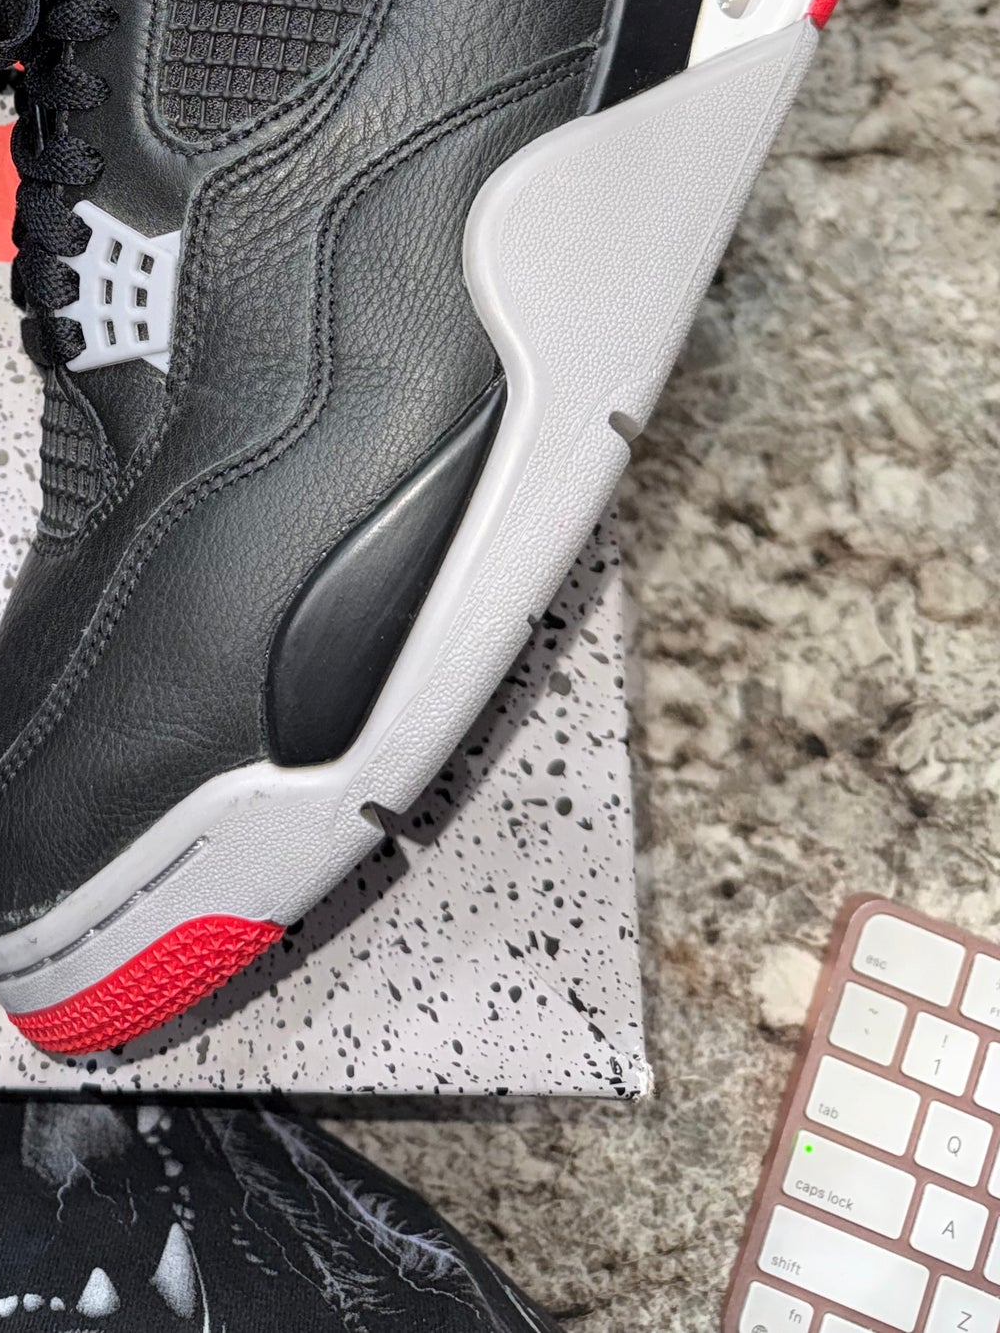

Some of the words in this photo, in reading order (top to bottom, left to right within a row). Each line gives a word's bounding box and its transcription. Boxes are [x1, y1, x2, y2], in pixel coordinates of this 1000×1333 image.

[865, 954, 888, 970] esc
[933, 1058, 942, 1076] 1
[817, 1102, 840, 1120] tab
[946, 1135, 962, 1158] Q
[795, 1178, 825, 1201] caps
[827, 1190, 854, 1212] lock
[941, 1220, 956, 1240] A
[770, 1255, 802, 1276] shift
[788, 1309, 803, 1325] fn
[956, 1310, 973, 1332] Z
